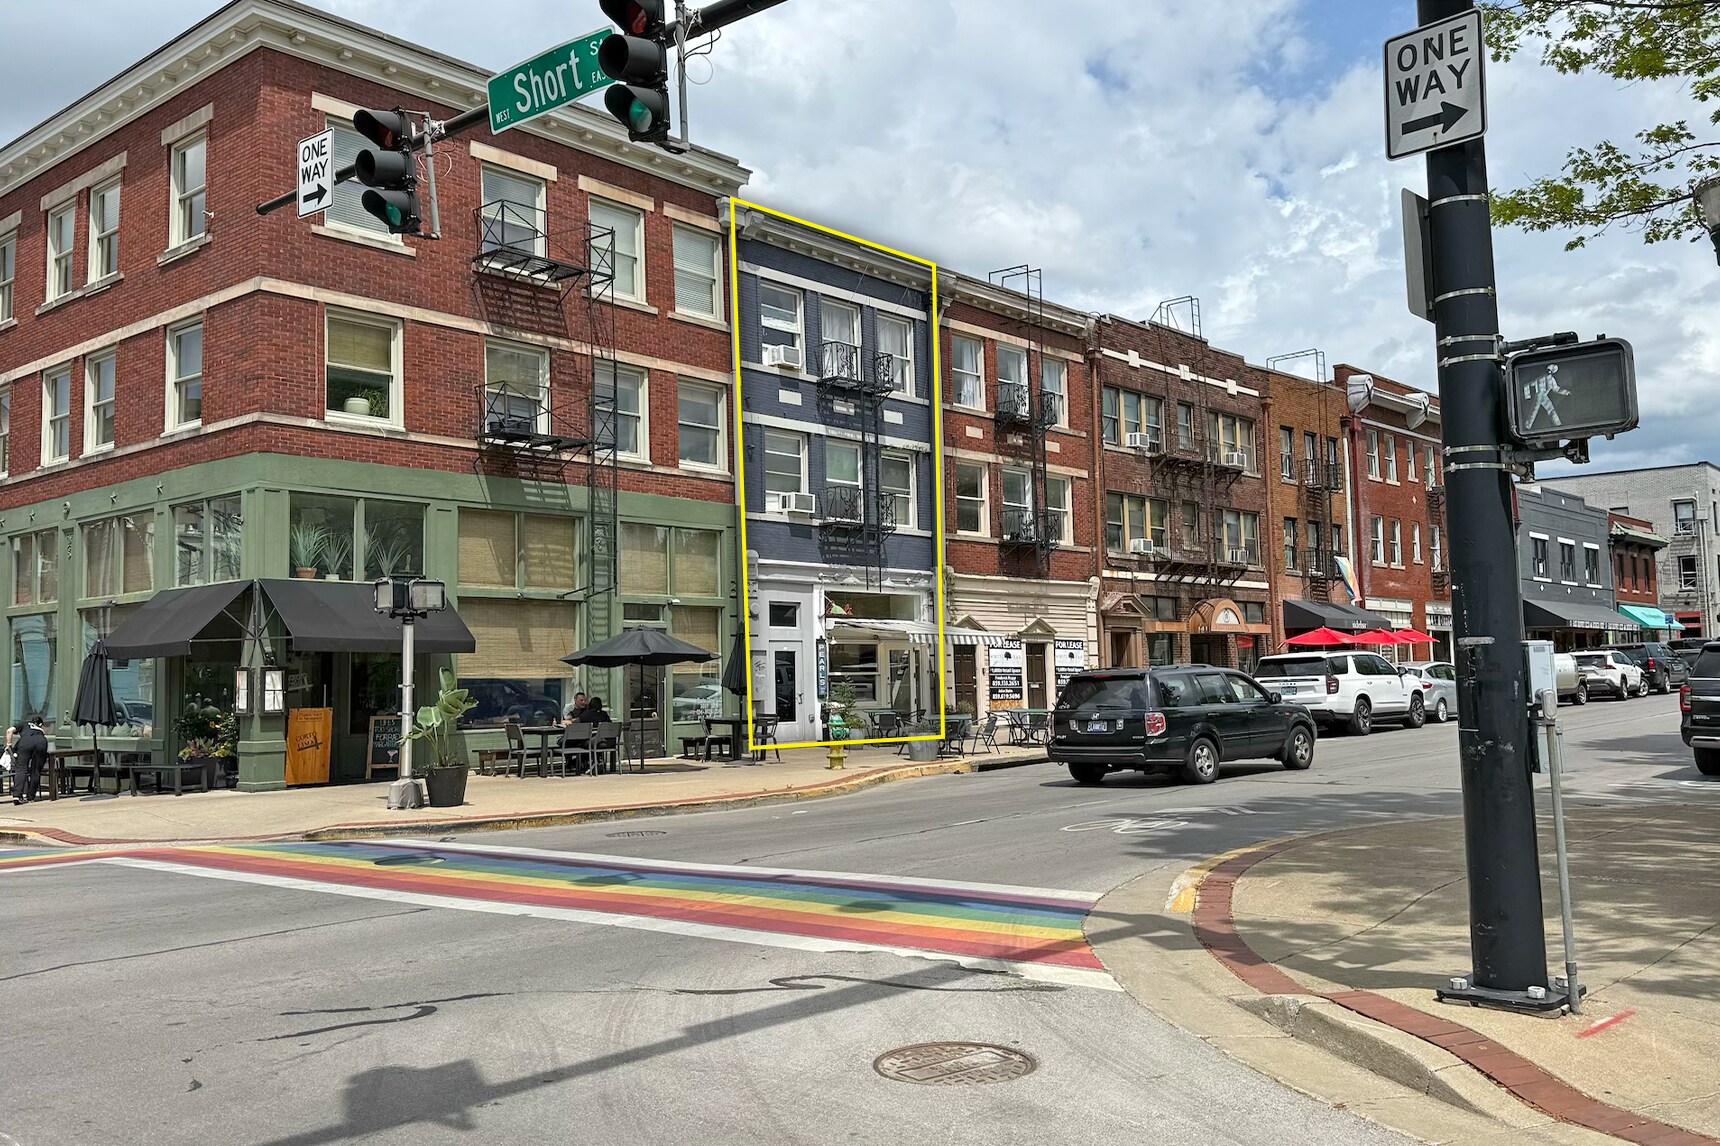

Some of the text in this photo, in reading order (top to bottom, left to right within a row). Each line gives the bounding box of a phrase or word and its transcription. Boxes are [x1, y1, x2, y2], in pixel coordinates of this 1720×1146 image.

[1396, 24, 1469, 72] ONE
[513, 48, 583, 113] Short
[1395, 57, 1472, 107] WAY
[495, 108, 510, 124] WEST
[302, 137, 328, 163] ONE
[301, 158, 329, 185] WAY
[1003, 640, 1021, 648] LEASE
[1067, 641, 1082, 649] LEASE
[295, 730, 317, 743] CORTO
[376, 733, 388, 741] FOR
